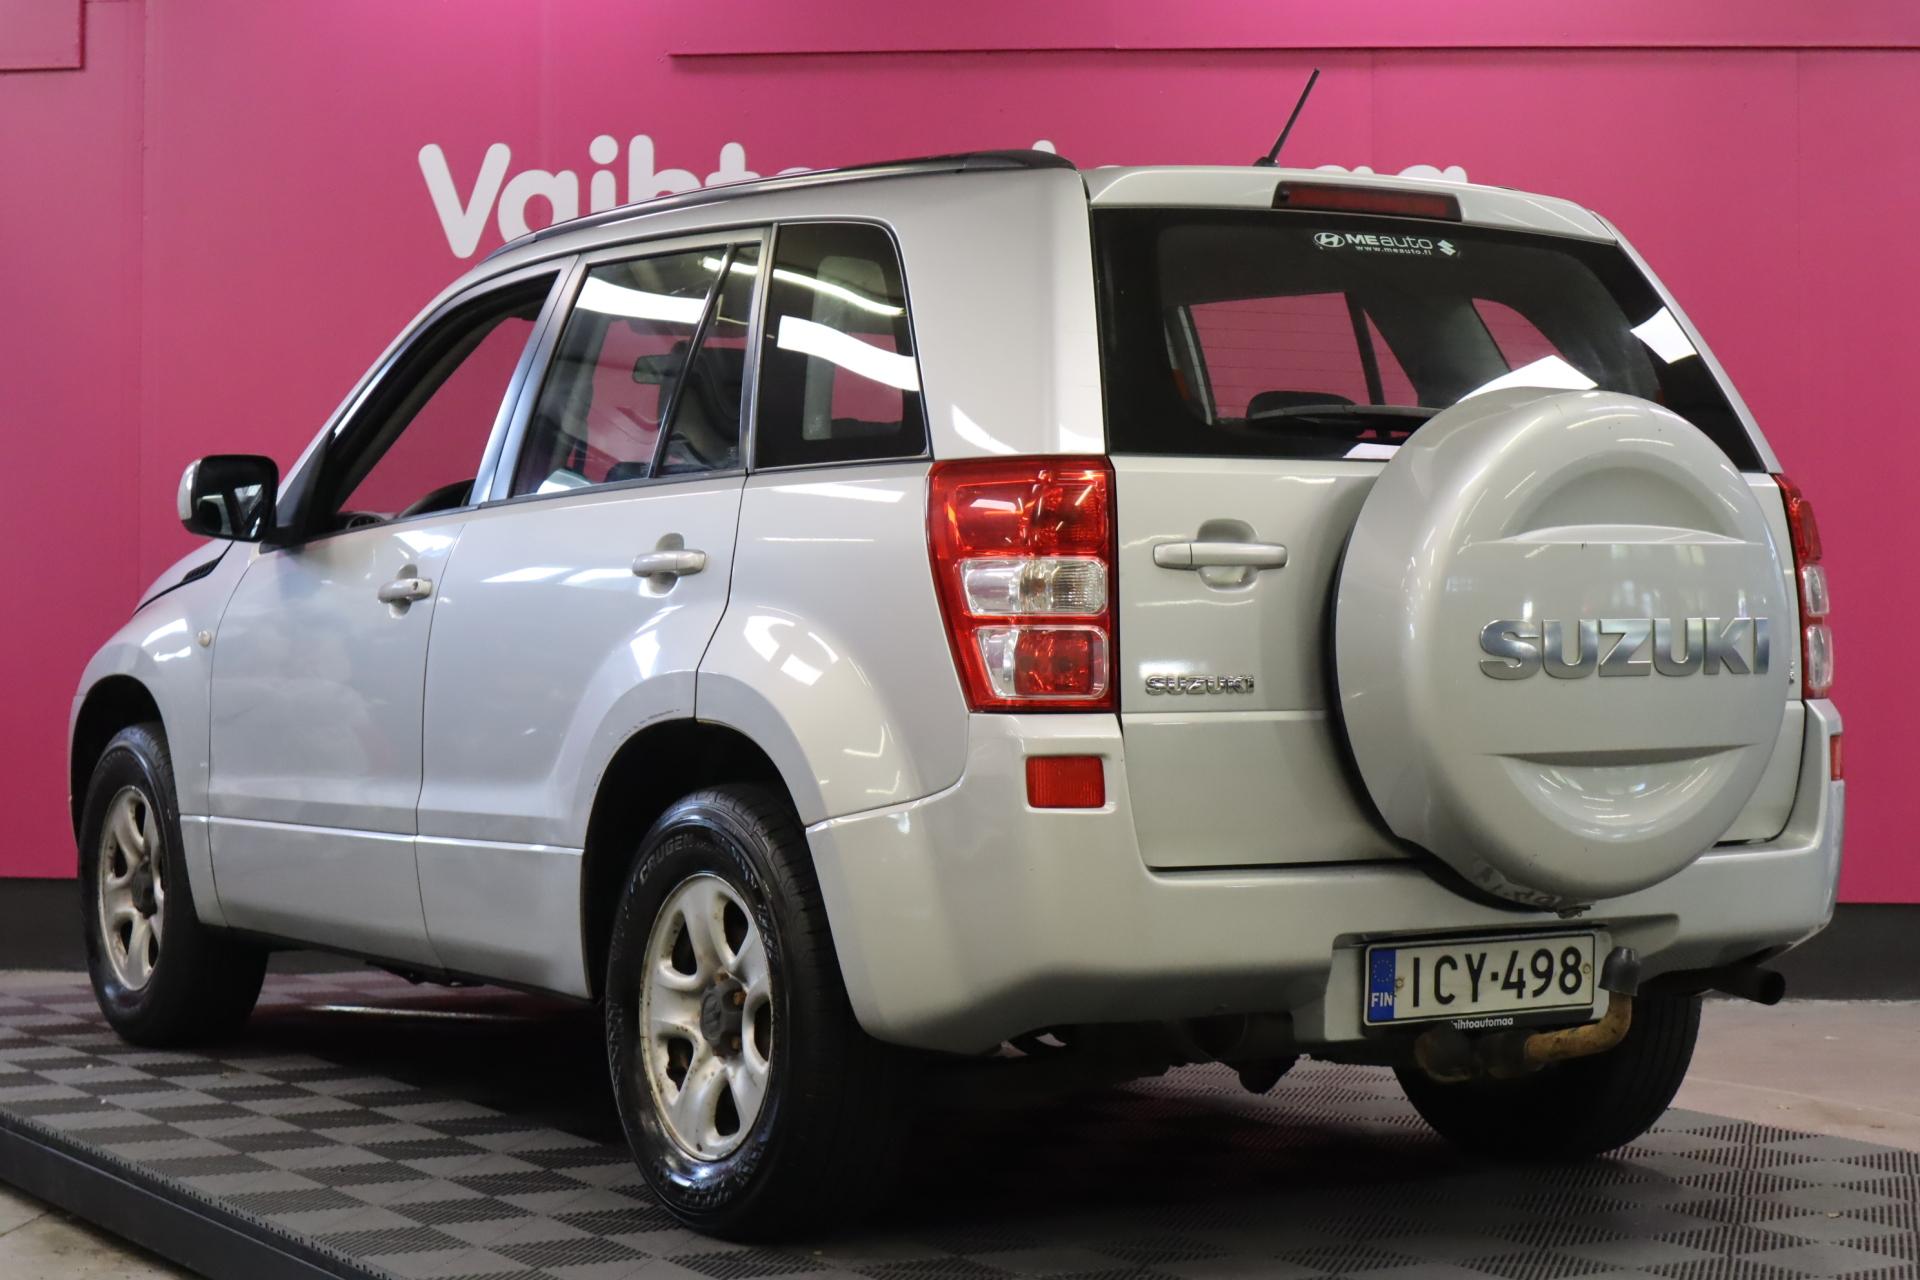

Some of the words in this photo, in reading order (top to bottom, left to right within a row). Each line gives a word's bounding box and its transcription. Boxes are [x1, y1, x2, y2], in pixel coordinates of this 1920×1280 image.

[1355, 245, 1432, 256] www.meauto.fi
[1480, 617, 1770, 681] SUZUKI
[1145, 674, 1255, 696] SUZUKI
[1412, 946, 1583, 1008] ICY-498
[1371, 992, 1393, 1008] FIN
